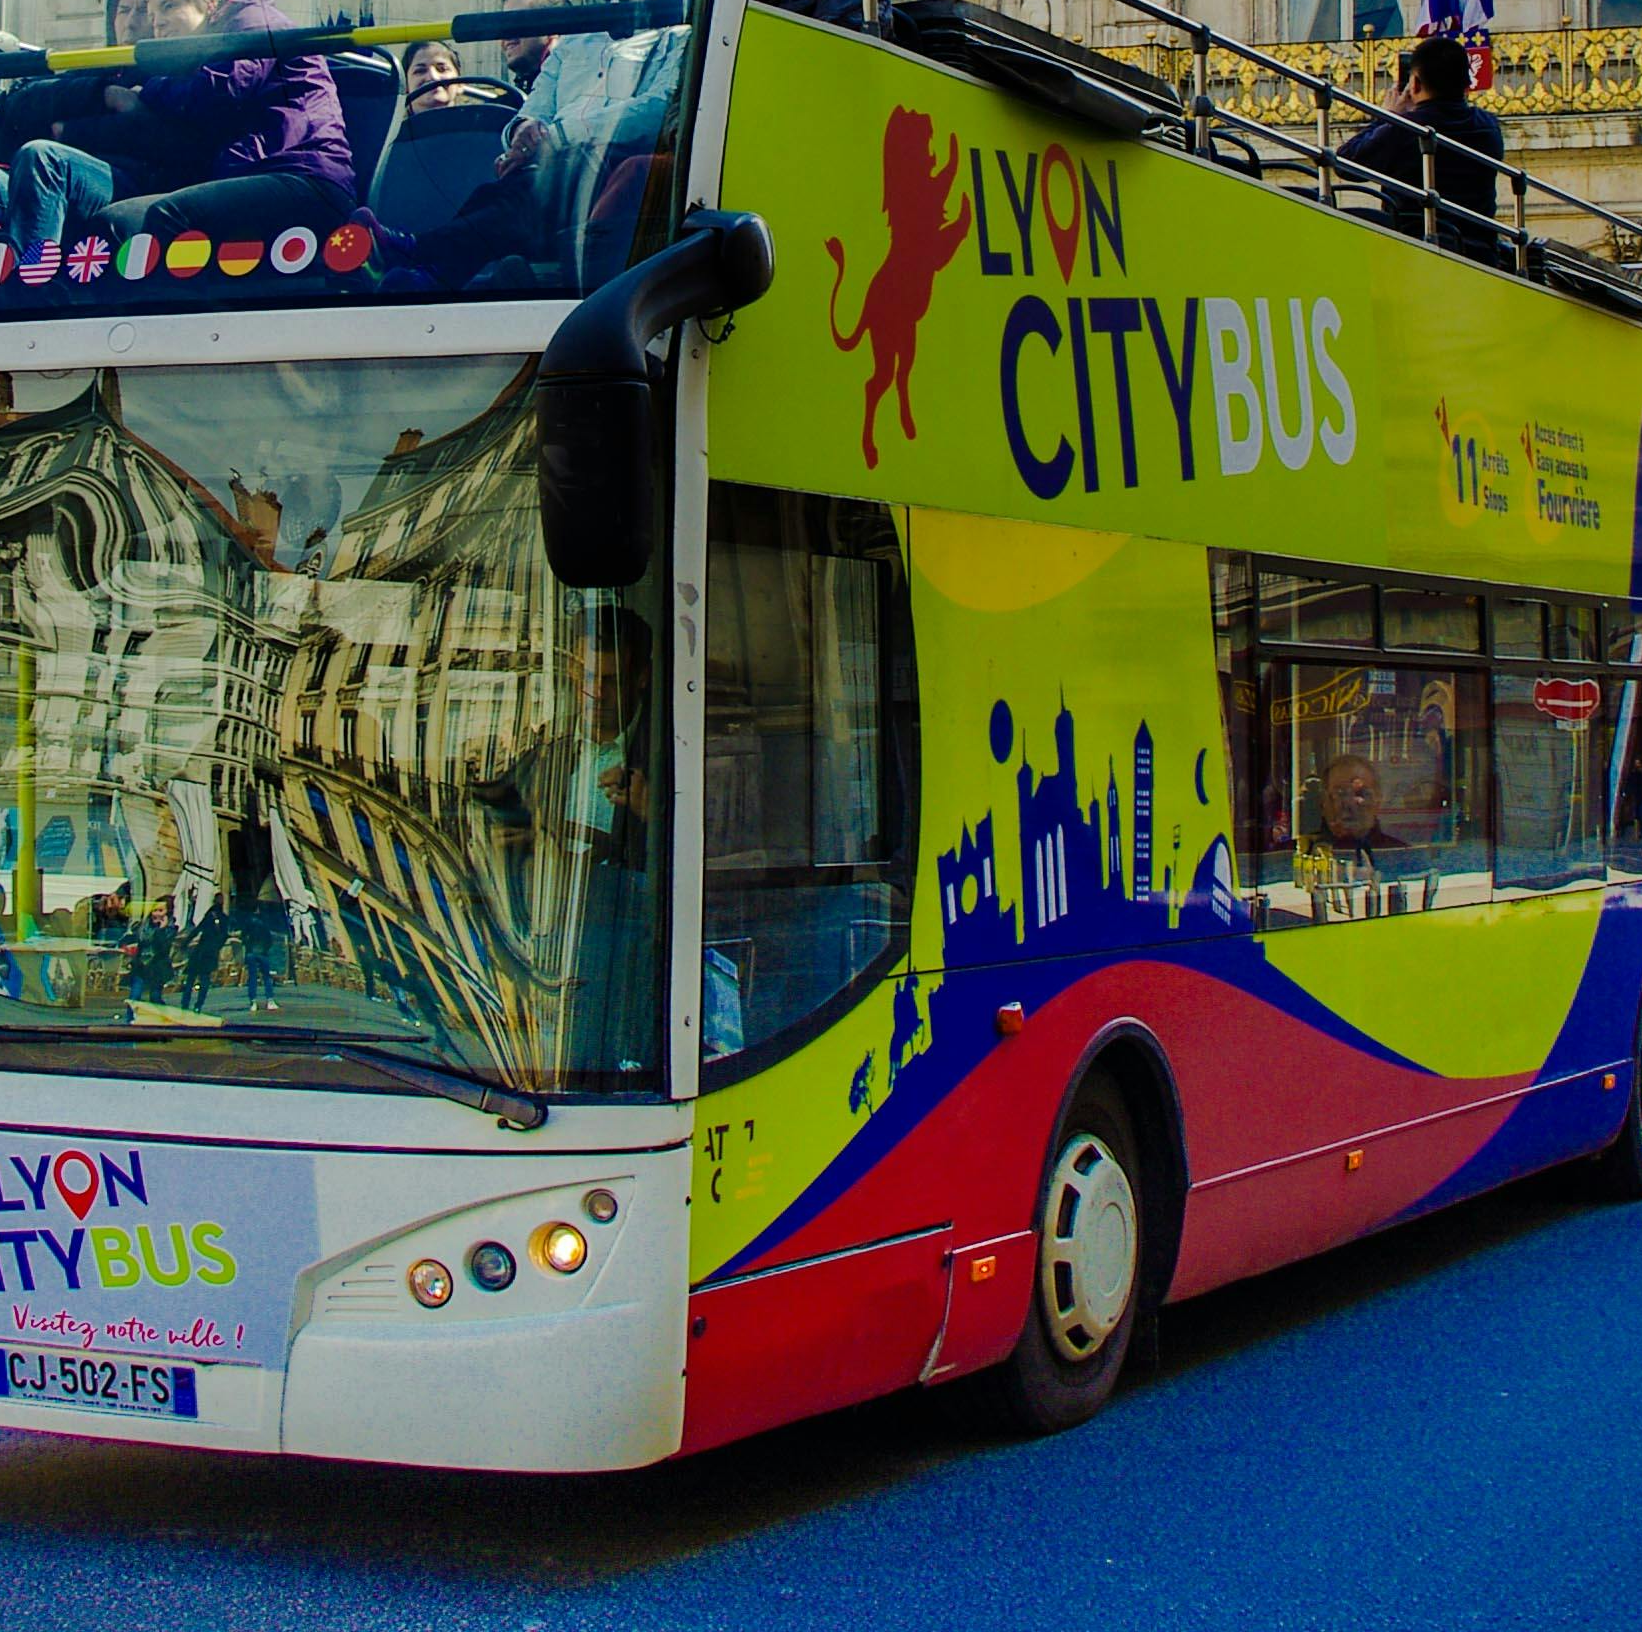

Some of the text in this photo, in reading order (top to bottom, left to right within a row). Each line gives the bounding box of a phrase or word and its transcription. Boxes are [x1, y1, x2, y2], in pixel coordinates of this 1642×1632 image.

[970, 142, 1128, 287] LYON
[1000, 294, 1357, 501] CITYBUS
[1452, 434, 1479, 506] 11
[1482, 447, 1510, 476] Arrêts
[1483, 485, 1509, 517] Stops
[1537, 478, 1601, 531] Fourvière
[12, 1302, 98, 1349] Visitez
[106, 1316, 161, 1344] notre
[168, 1318, 226, 1348] ville
[8, 1352, 171, 1404] CJ-502-FS
